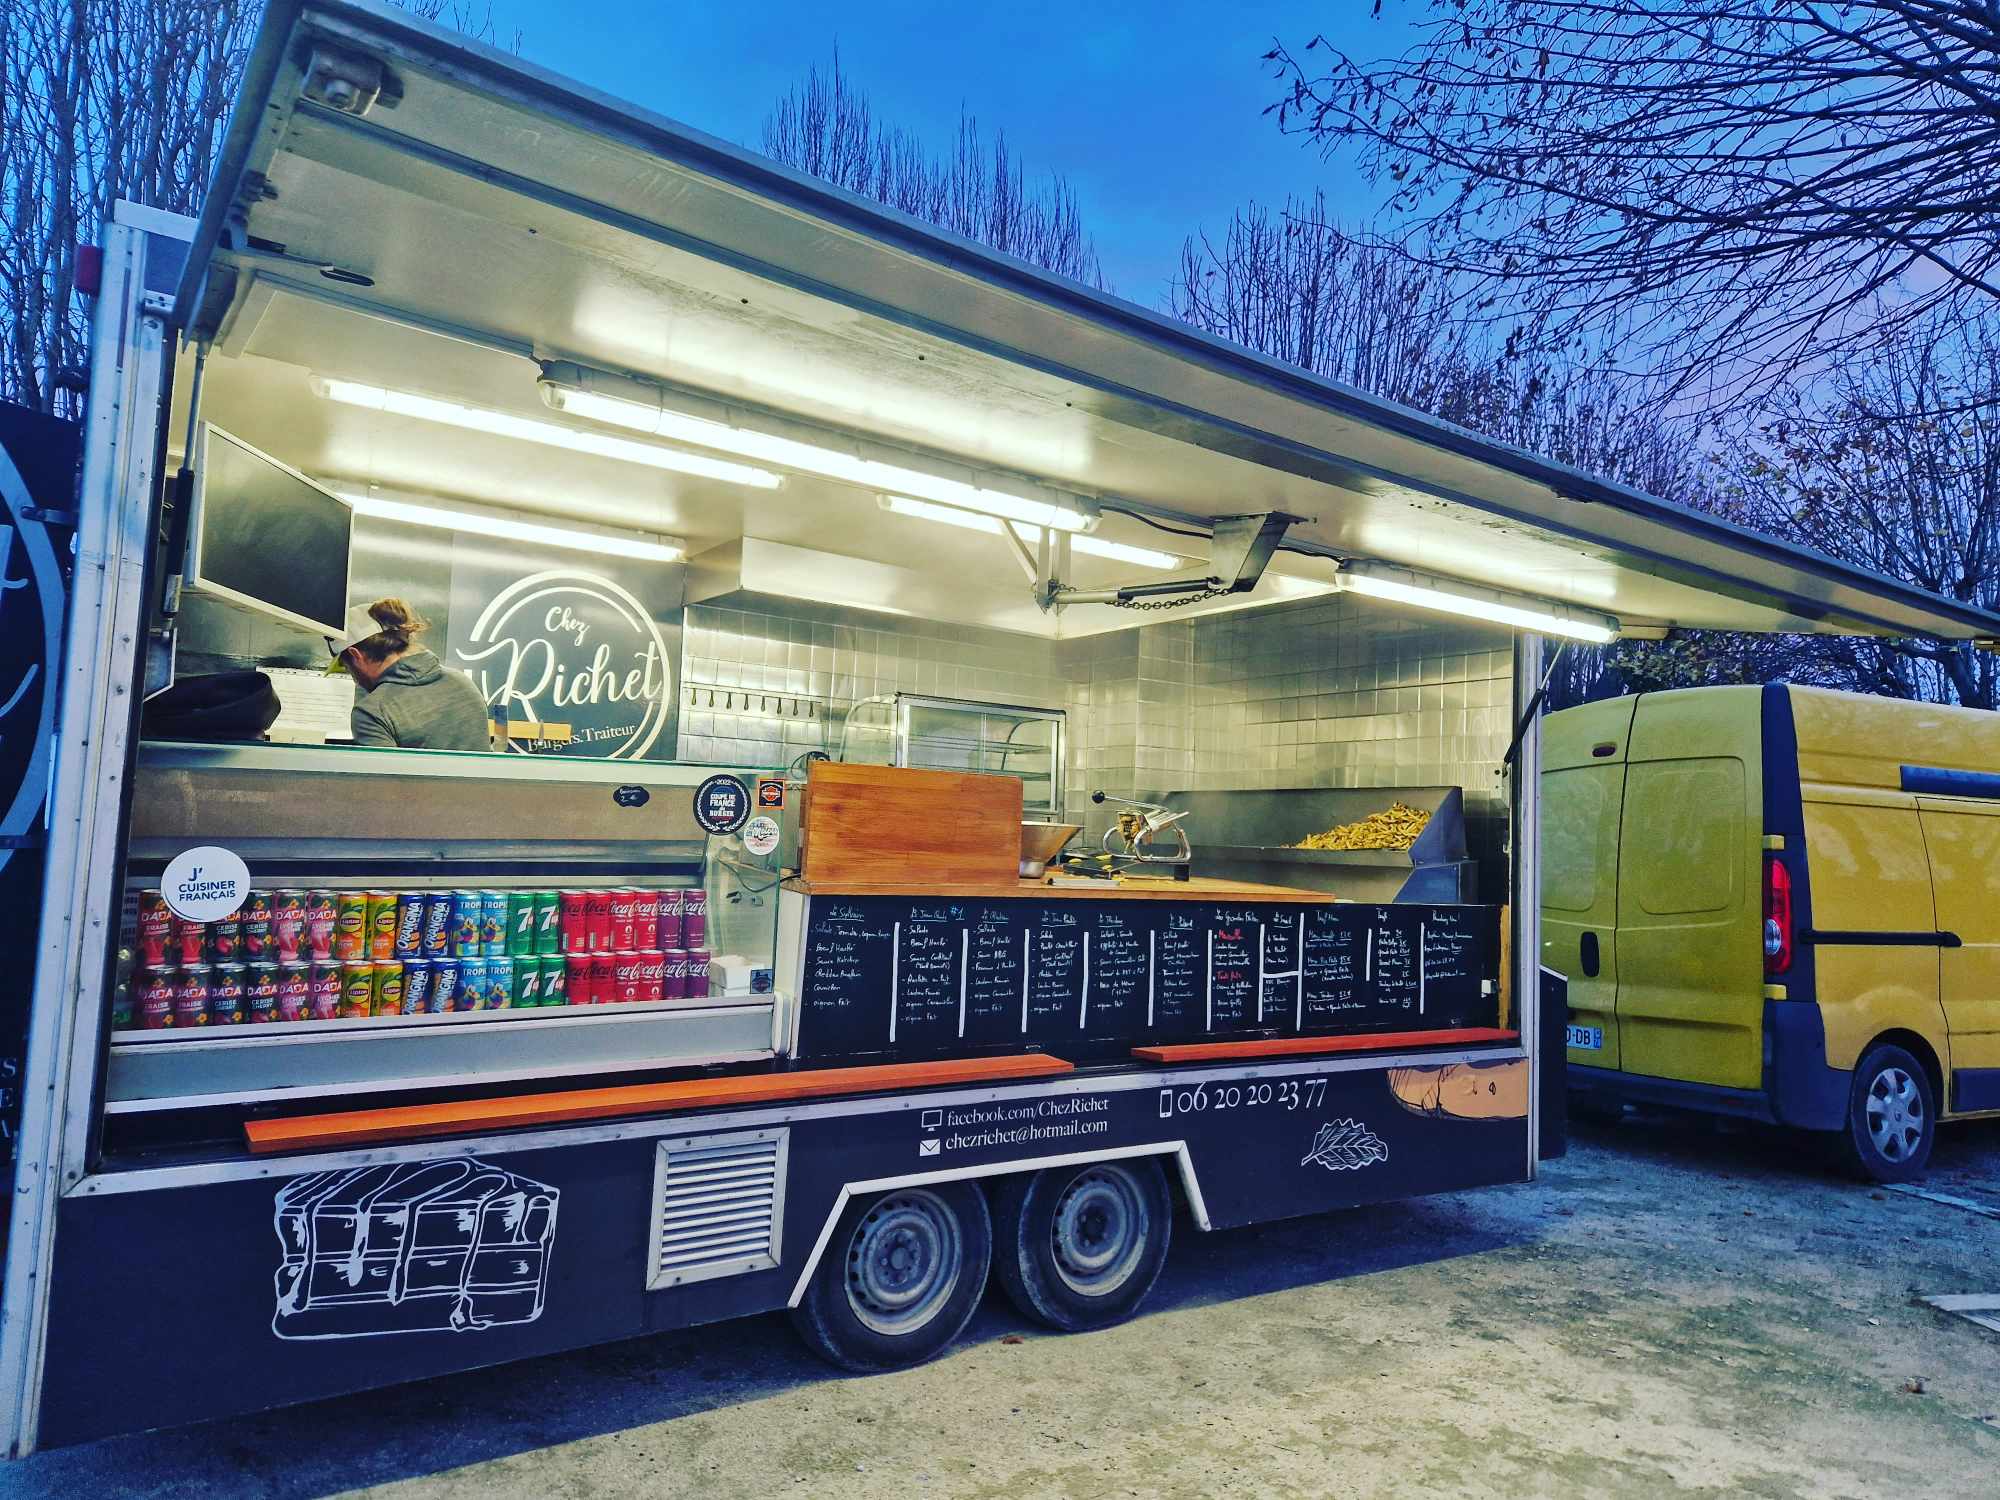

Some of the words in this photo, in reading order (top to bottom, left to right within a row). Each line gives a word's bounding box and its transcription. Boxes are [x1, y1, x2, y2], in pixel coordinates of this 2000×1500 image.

[545, 606, 590, 647] Chez
[456, 638, 661, 723] Richet
[710, 799, 737, 807] FRANCE
[178, 880, 236, 893] CUISINER
[178, 891, 236, 902] FRANÇAIS
[242, 909, 272, 921] DADA
[276, 909, 306, 921] DADA
[309, 909, 337, 921] DADA
[397, 902, 424, 949] ORANGINA
[425, 902, 451, 949] ORANGINA
[247, 984, 278, 997] DADA
[280, 982, 309, 995] DADA
[313, 981, 342, 993] DADA
[1177, 1080, 1208, 1113] 06
[1214, 1087, 1241, 1110] 20
[1246, 1084, 1273, 1106] 20
[1277, 1081, 1300, 1111] 23
[1304, 1078, 1328, 1109] 77
[947, 1097, 1110, 1127] facebook.com/ChezRichet
[945, 1119, 1108, 1150] chezrichet@hotmail.com
